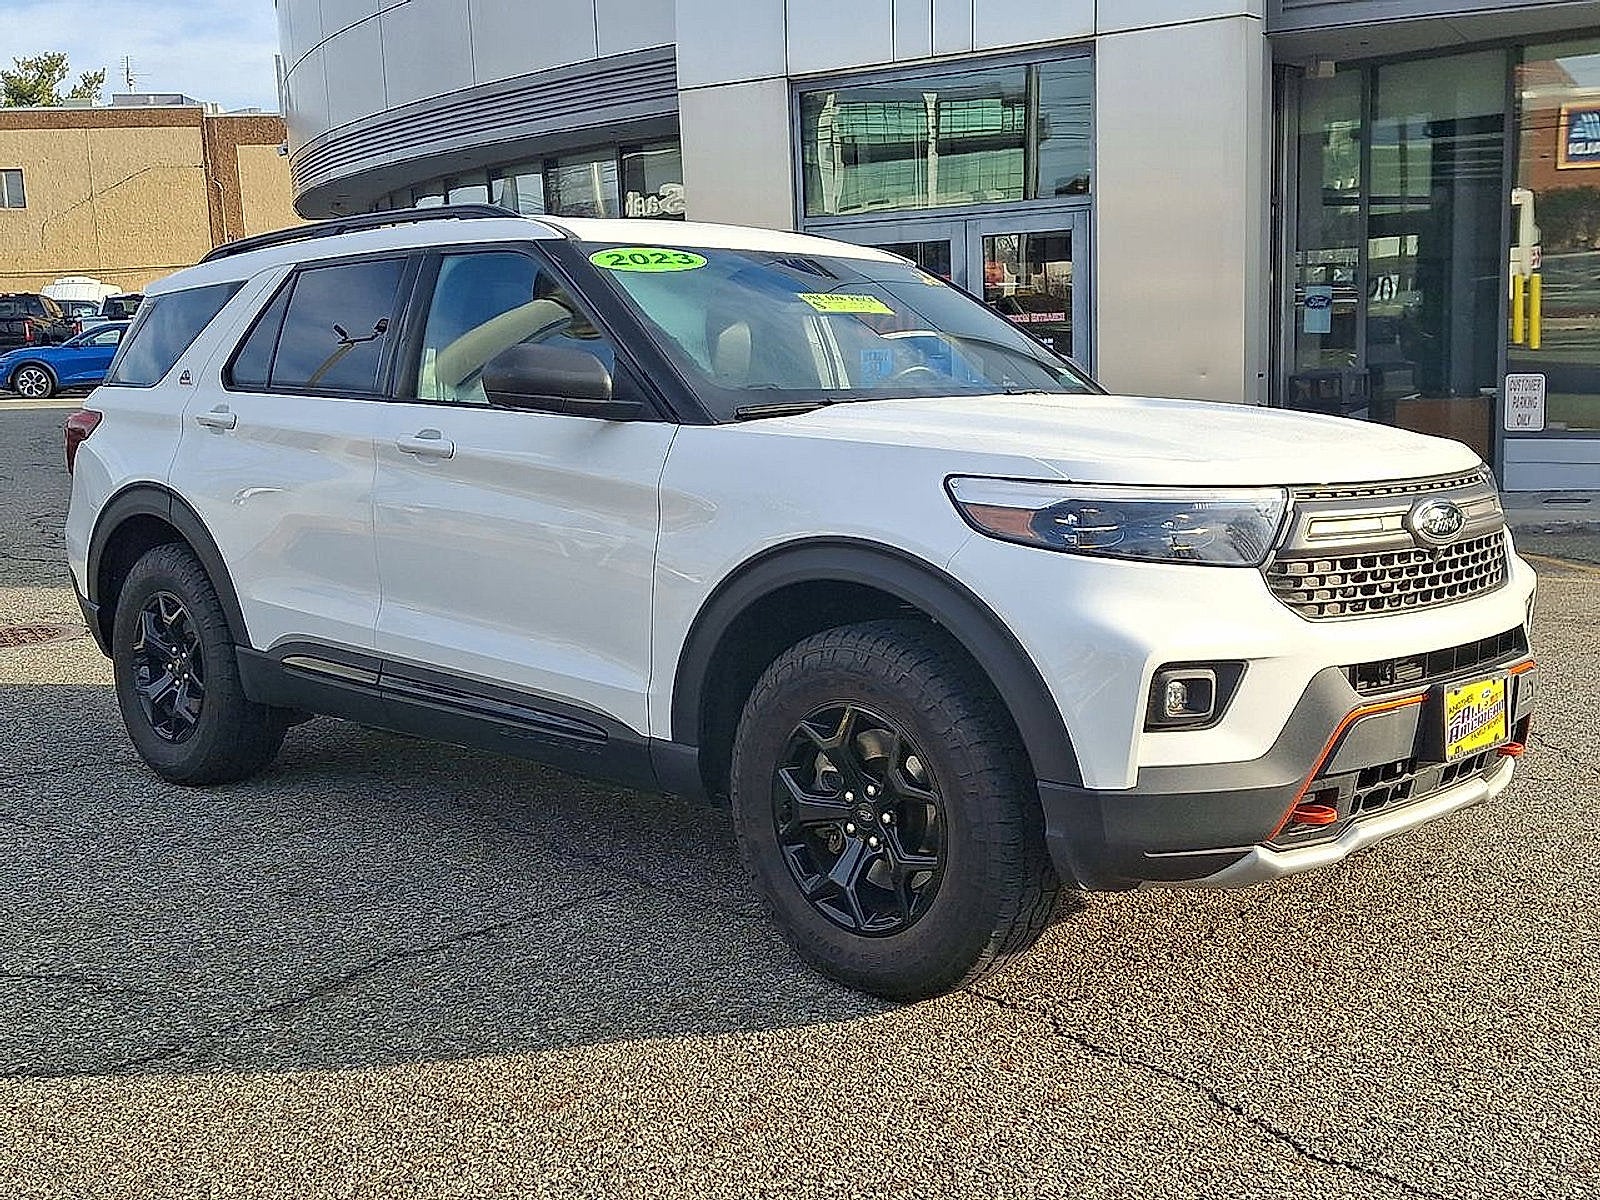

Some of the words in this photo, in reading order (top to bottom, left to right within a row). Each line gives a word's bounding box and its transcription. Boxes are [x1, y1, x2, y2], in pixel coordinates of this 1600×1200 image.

[606, 253, 694, 266] 2023
[1509, 379, 1541, 391] CUSTOMER
[1512, 396, 1538, 409] PARKING
[1516, 413, 1532, 427] ONLY
